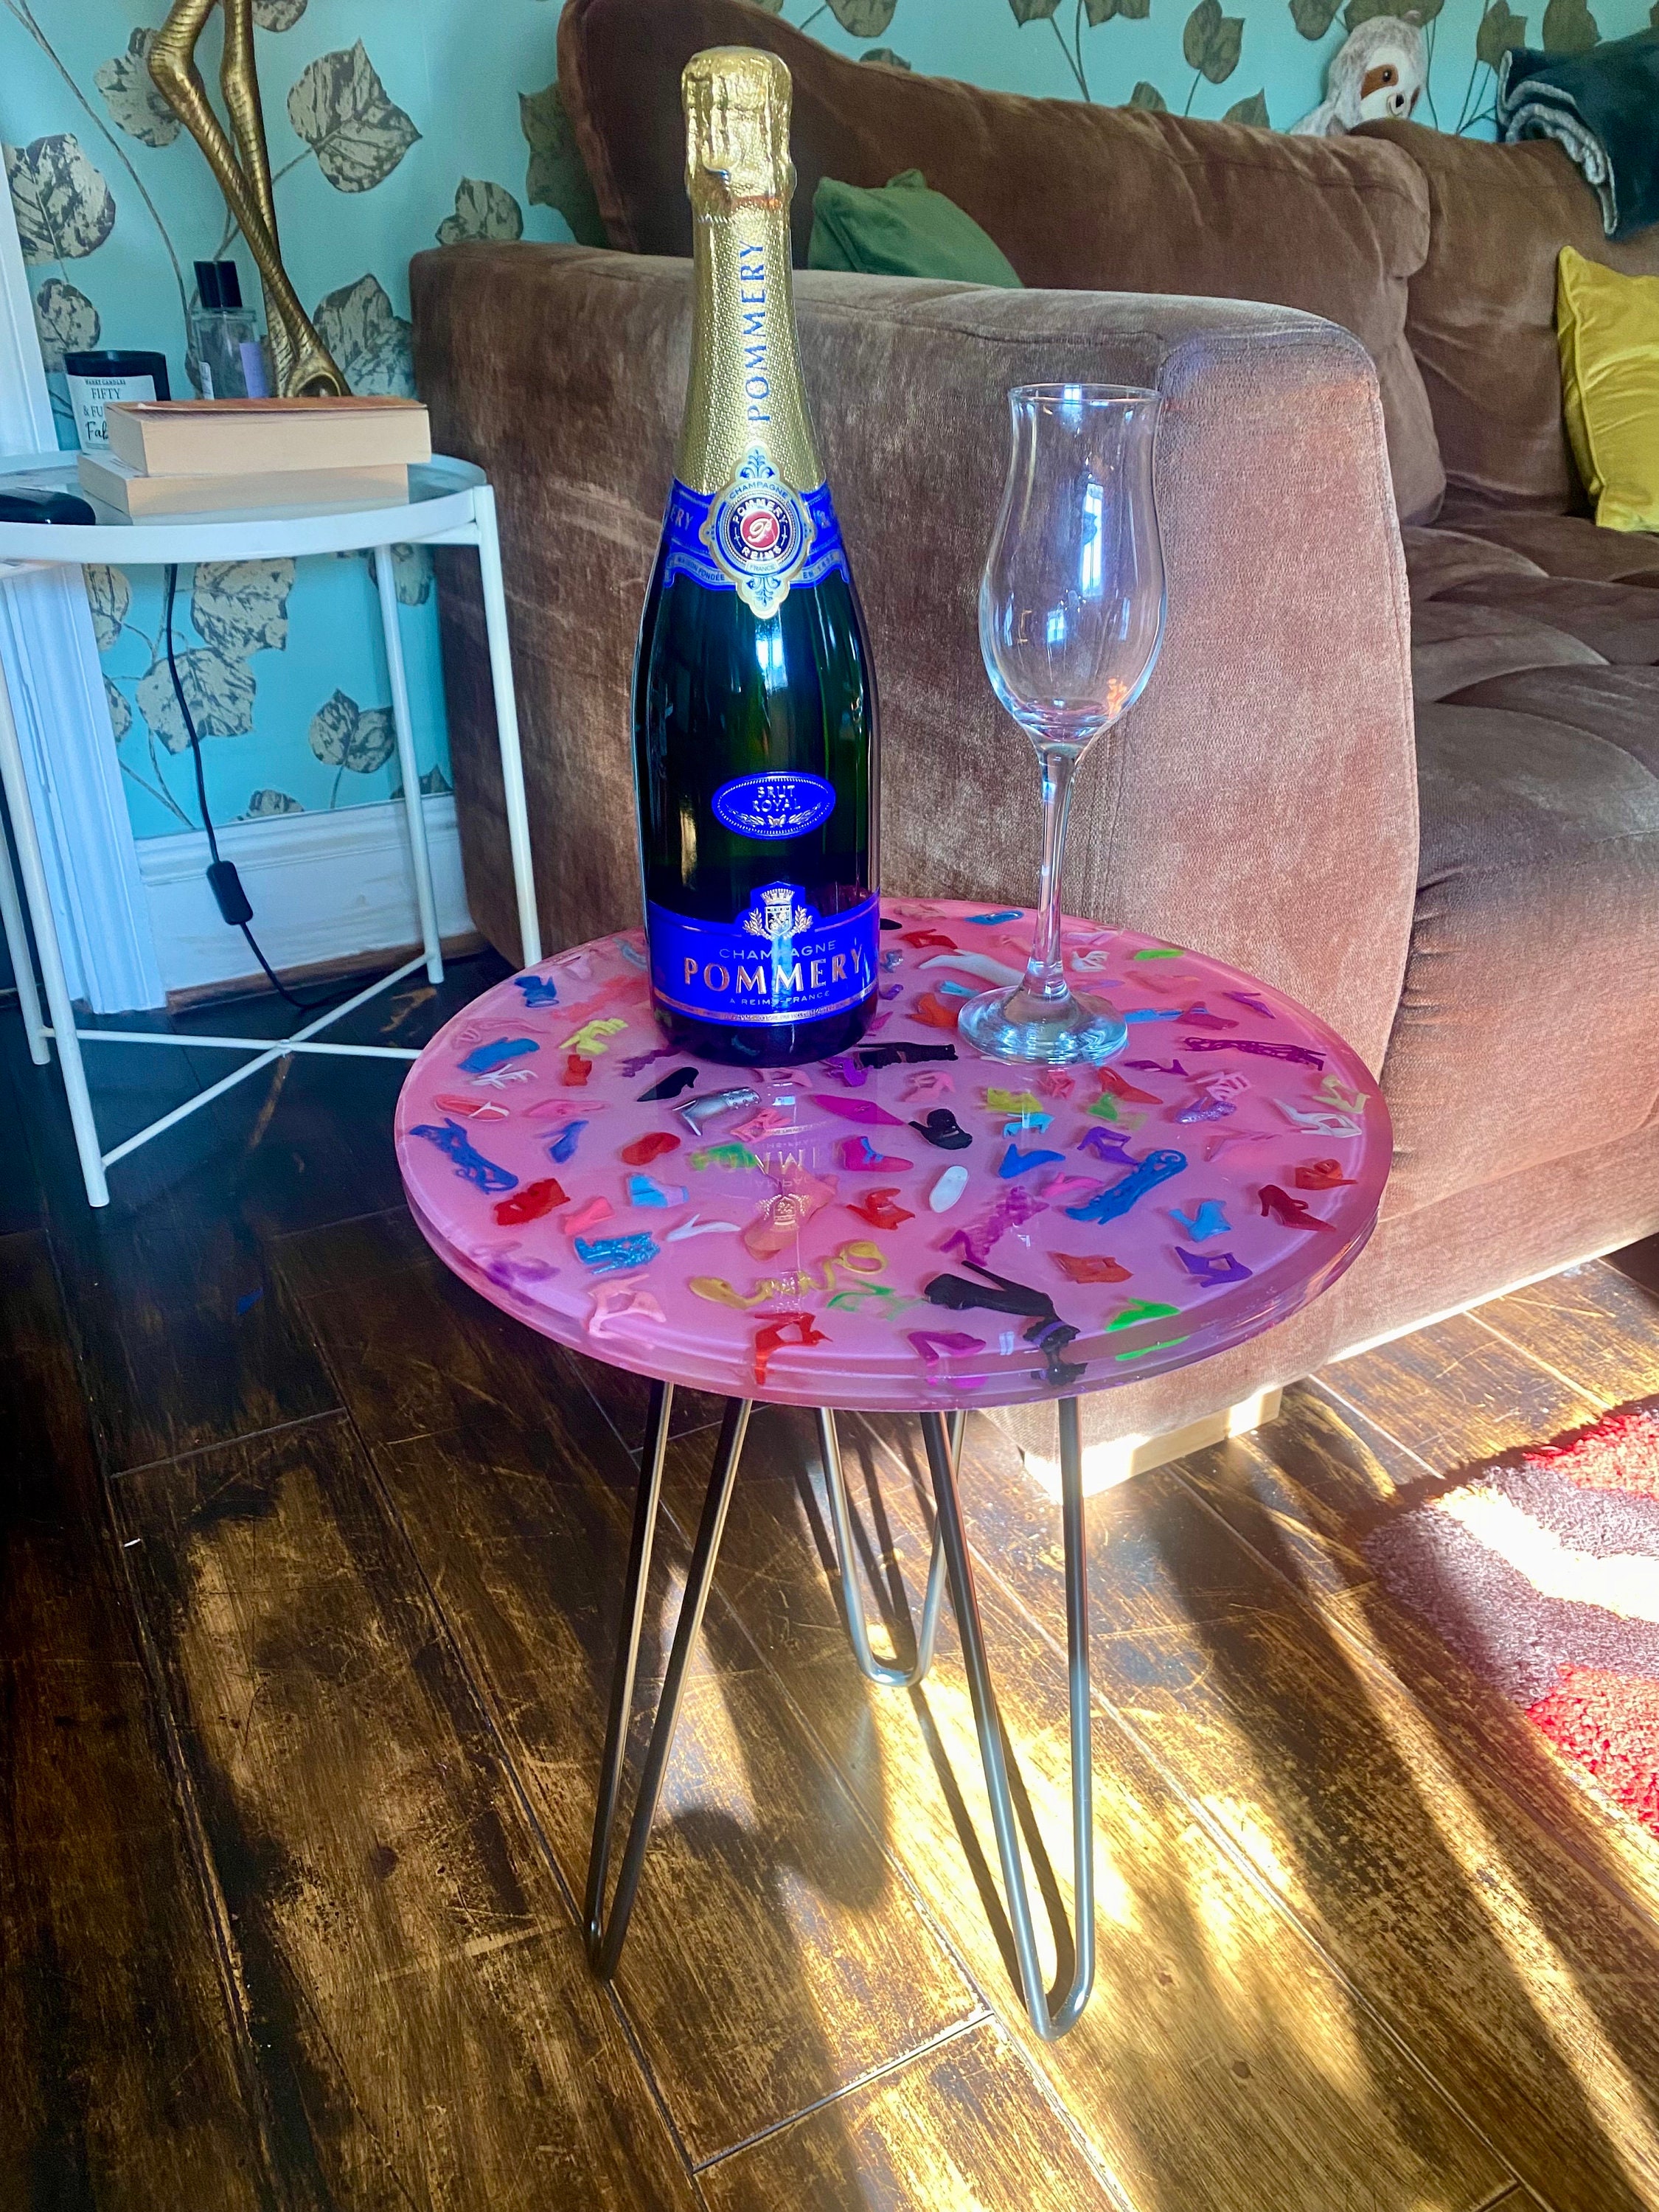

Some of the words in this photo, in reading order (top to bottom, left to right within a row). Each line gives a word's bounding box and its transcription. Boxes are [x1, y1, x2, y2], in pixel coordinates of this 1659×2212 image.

[740, 240, 771, 422] POMMERY
[91, 388, 120, 399] FIFTY
[83, 405, 89, 417] &
[729, 481, 789, 500] CHAMPAGNE
[732, 498, 788, 524] POMMERY
[741, 546, 782, 561] REIMS
[749, 563, 776, 572] FRANCE
[757, 785, 796, 799] BRUT
[752, 799, 801, 813] ROYAL
[719, 940, 837, 961] CHAMAGNE
[684, 943, 863, 995] POMMERY
